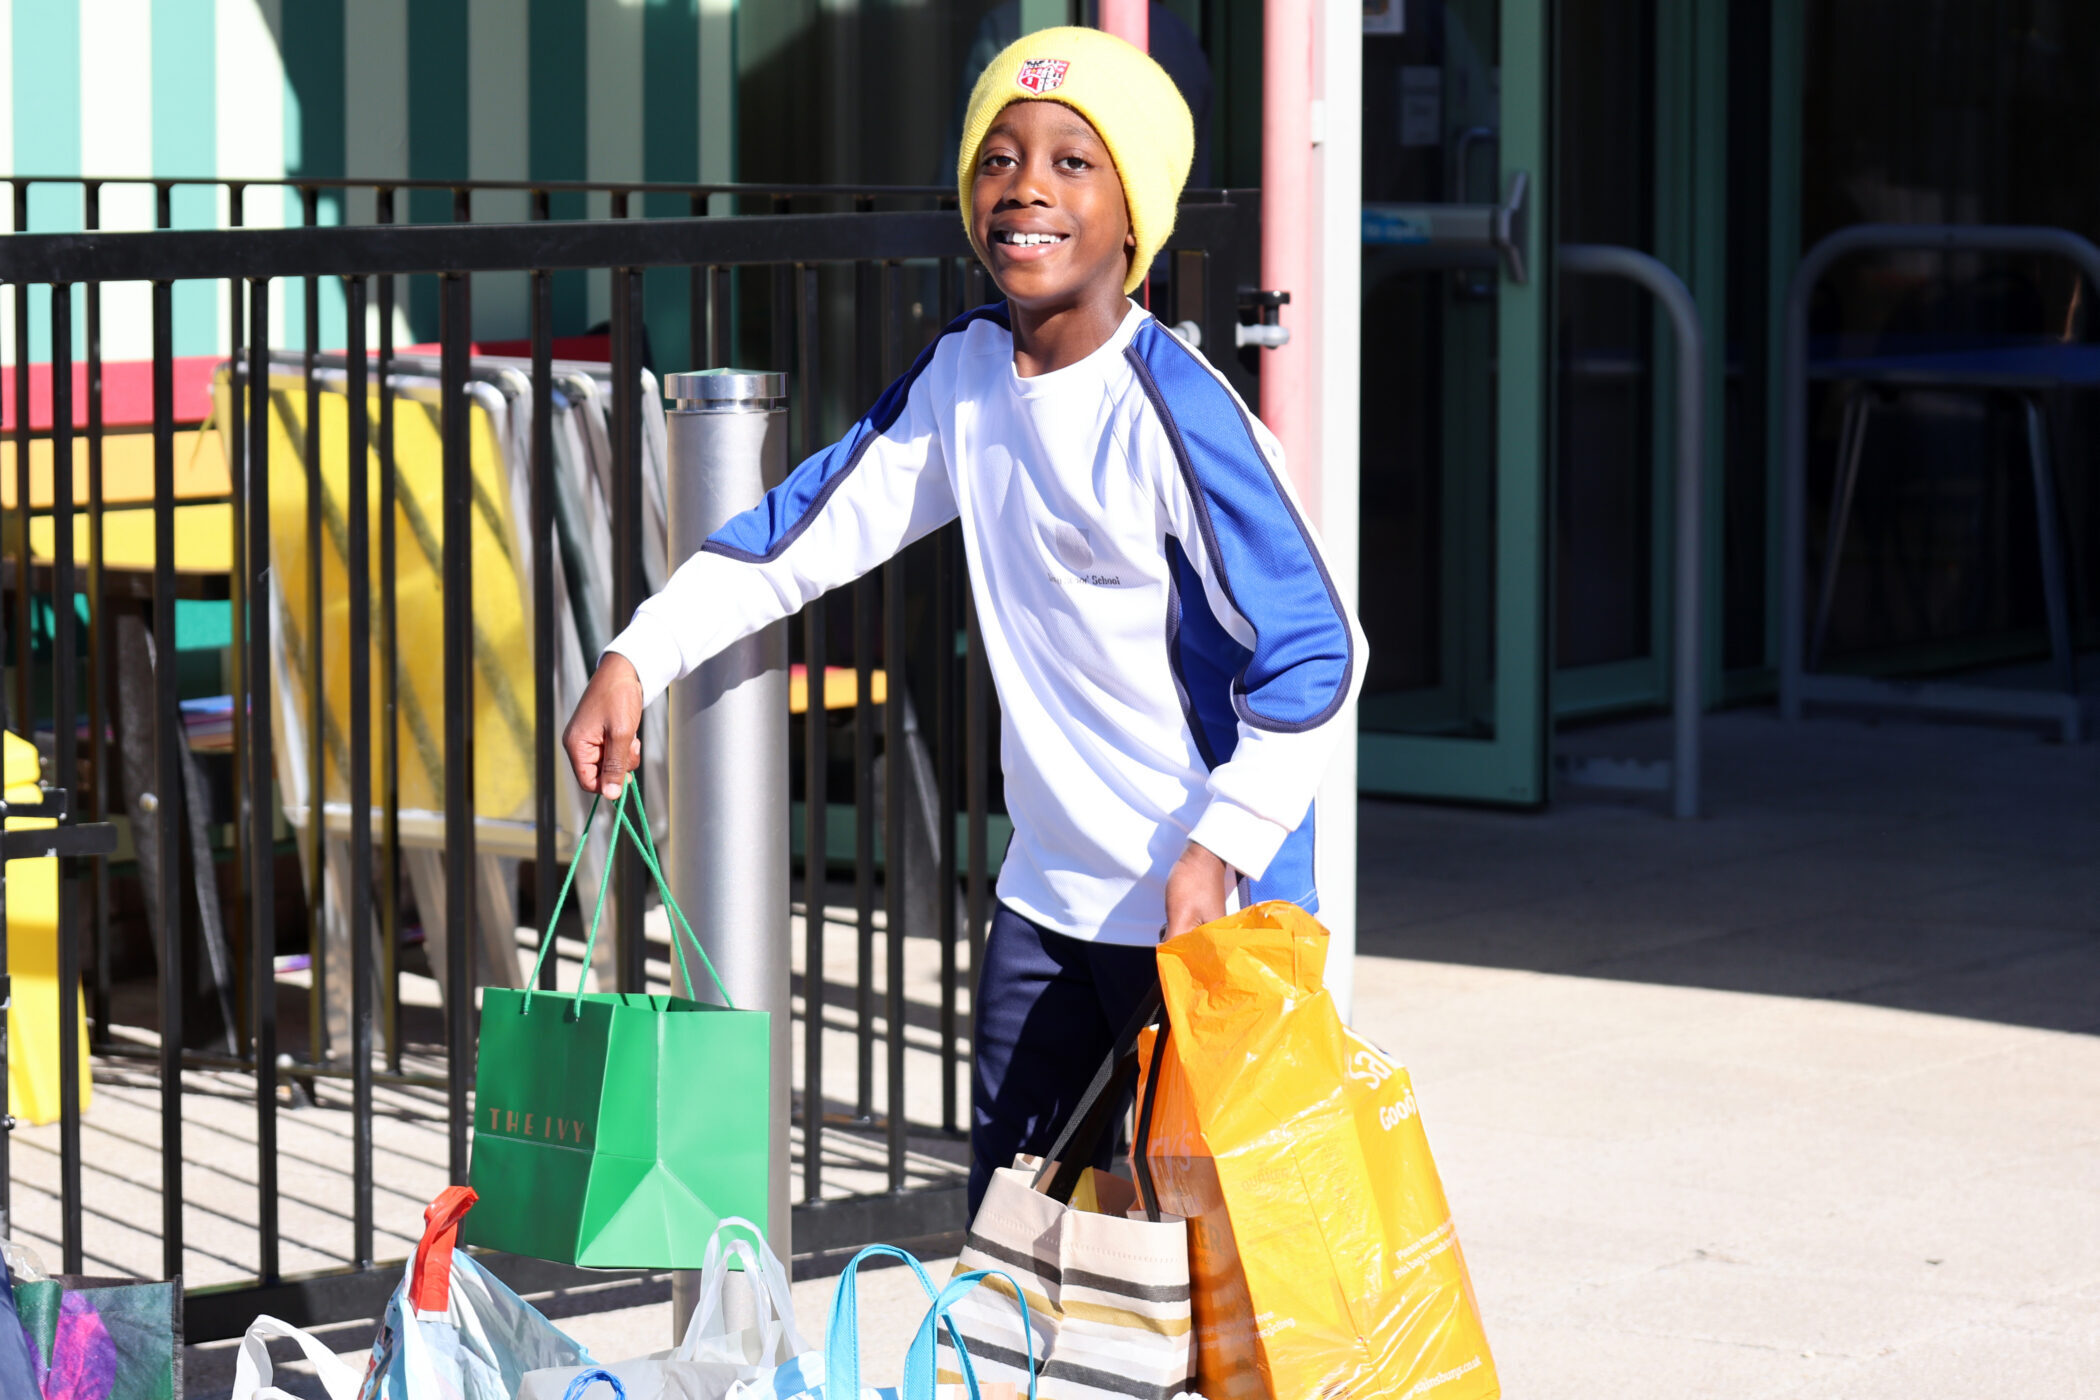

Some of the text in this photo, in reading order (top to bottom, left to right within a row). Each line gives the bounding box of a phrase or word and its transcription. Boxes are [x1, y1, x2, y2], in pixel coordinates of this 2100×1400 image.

[1091, 575, 1120, 585] School
[489, 1107, 585, 1143] THE IVY
[1406, 1256, 1425, 1270] bag
